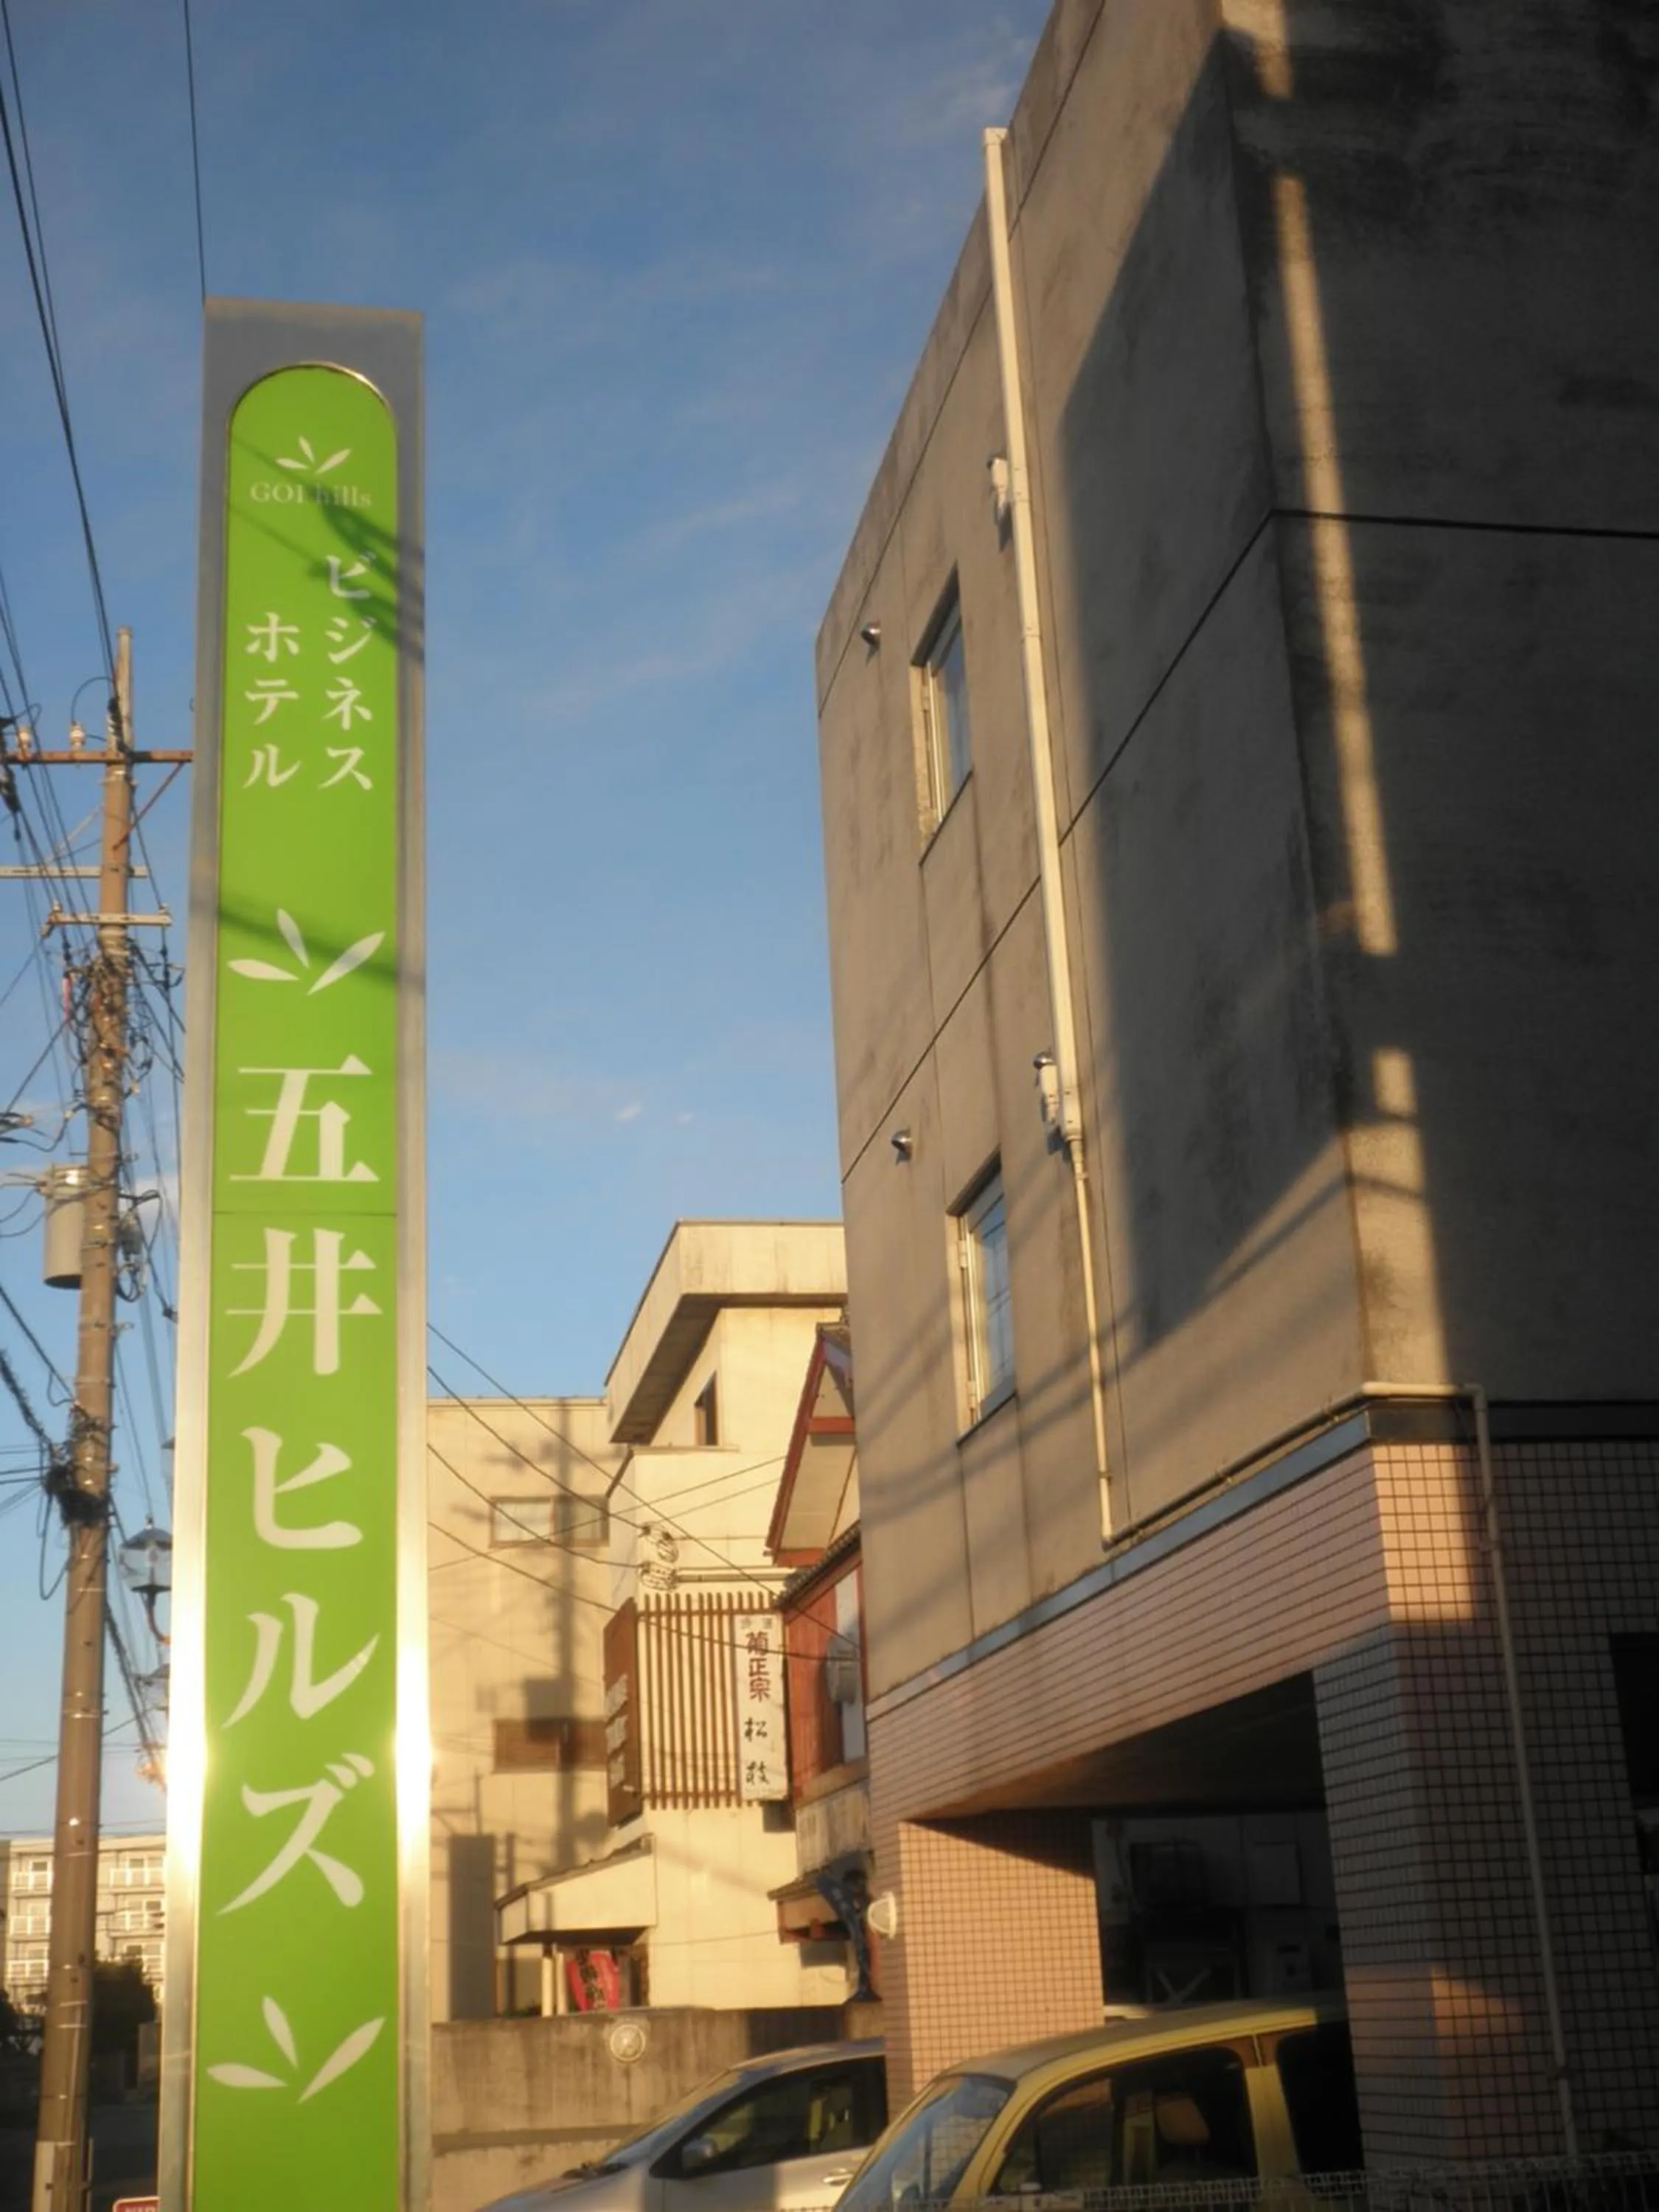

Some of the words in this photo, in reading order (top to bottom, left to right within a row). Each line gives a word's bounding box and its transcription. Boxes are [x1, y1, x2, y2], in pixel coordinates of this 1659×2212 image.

[242, 612, 302, 790] ホテル
[317, 551, 375, 791] ビジネス
[216, 1054, 383, 1916] 五井ヒルズ
